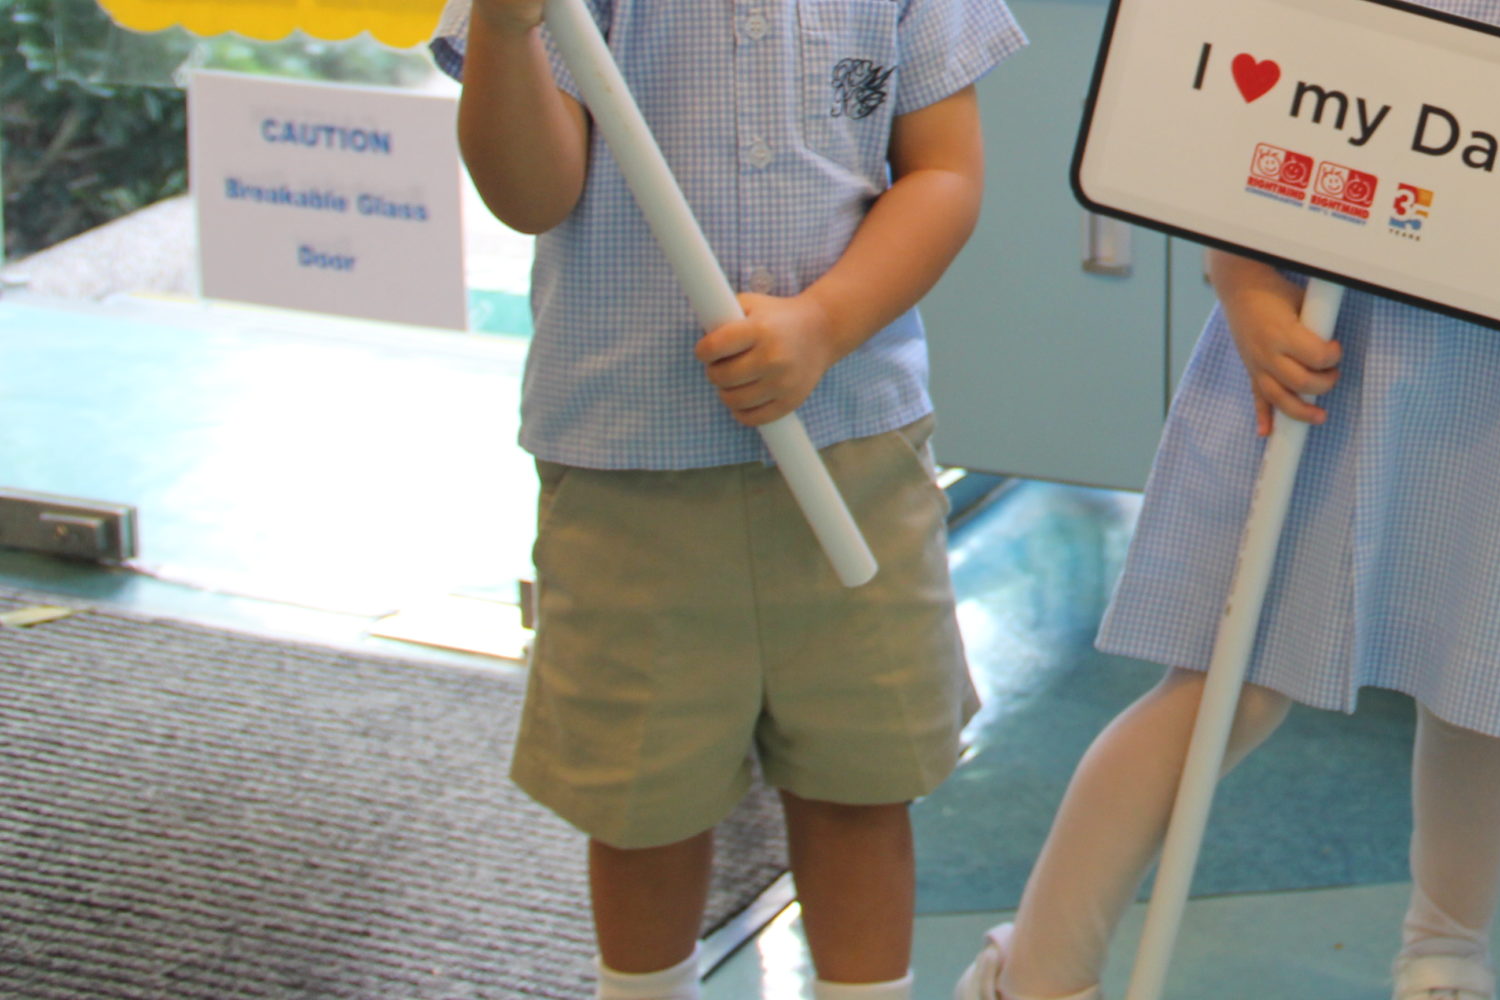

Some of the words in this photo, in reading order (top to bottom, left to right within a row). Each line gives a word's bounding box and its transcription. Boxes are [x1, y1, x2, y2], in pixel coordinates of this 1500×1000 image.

[1191, 41, 1213, 91] I
[1289, 81, 1391, 148] my
[261, 118, 392, 154] CAUTION
[225, 177, 347, 213] Breakable
[356, 194, 428, 222] Glass
[298, 245, 355, 271] Door
